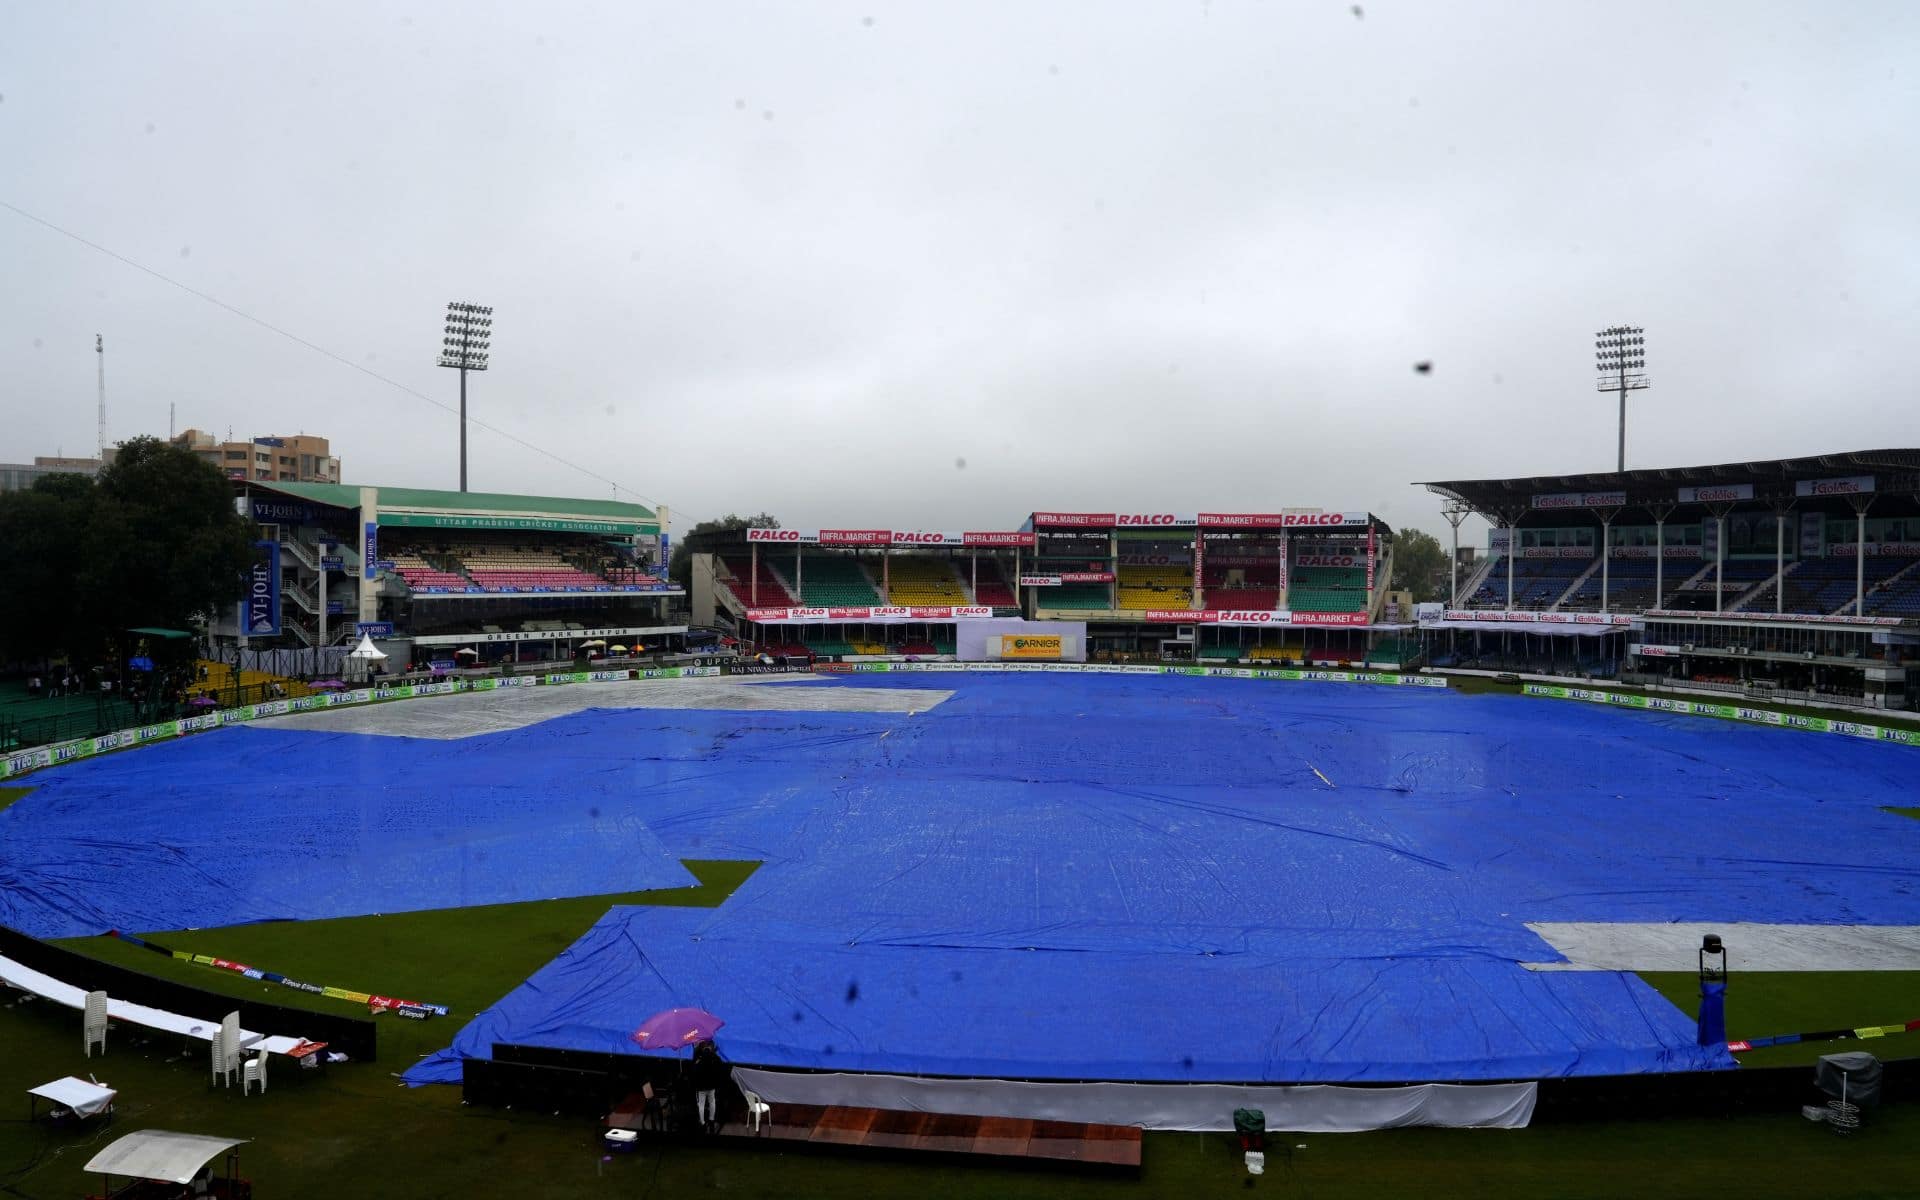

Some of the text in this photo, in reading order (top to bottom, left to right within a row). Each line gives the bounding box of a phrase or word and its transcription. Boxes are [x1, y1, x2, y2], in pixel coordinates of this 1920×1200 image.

[1816, 482, 1859, 495] Goldiee
[1699, 490, 1737, 502] Goldiee
[255, 503, 305, 521] VI-JOHN
[435, 518, 619, 532] UTTAR PRADESH CRICKET ASSOCIATION
[1036, 515, 1089, 524] INFRA.MARKET
[1118, 514, 1175, 525] RALCO
[1200, 516, 1253, 525] INFRA.MARKET
[1284, 514, 1343, 525] RALCO
[749, 530, 800, 541] RALCO
[821, 533, 876, 541] INFRA.MARKET
[893, 532, 944, 543] RALCO
[965, 534, 1020, 543] INFRA.MARKET
[367, 538, 376, 567] VI-JOHN
[1298, 556, 1353, 567] RALCO
[1062, 573, 1102, 581] INFRA.MARKET
[1147, 611, 1202, 620] INFRA.MARKET
[1219, 611, 1271, 622] RALCO
[1292, 613, 1350, 623] INFRA.MARKET
[363, 623, 387, 635] VI-JOHN
[487, 627, 628, 642] GREEN PARK KANPUR
